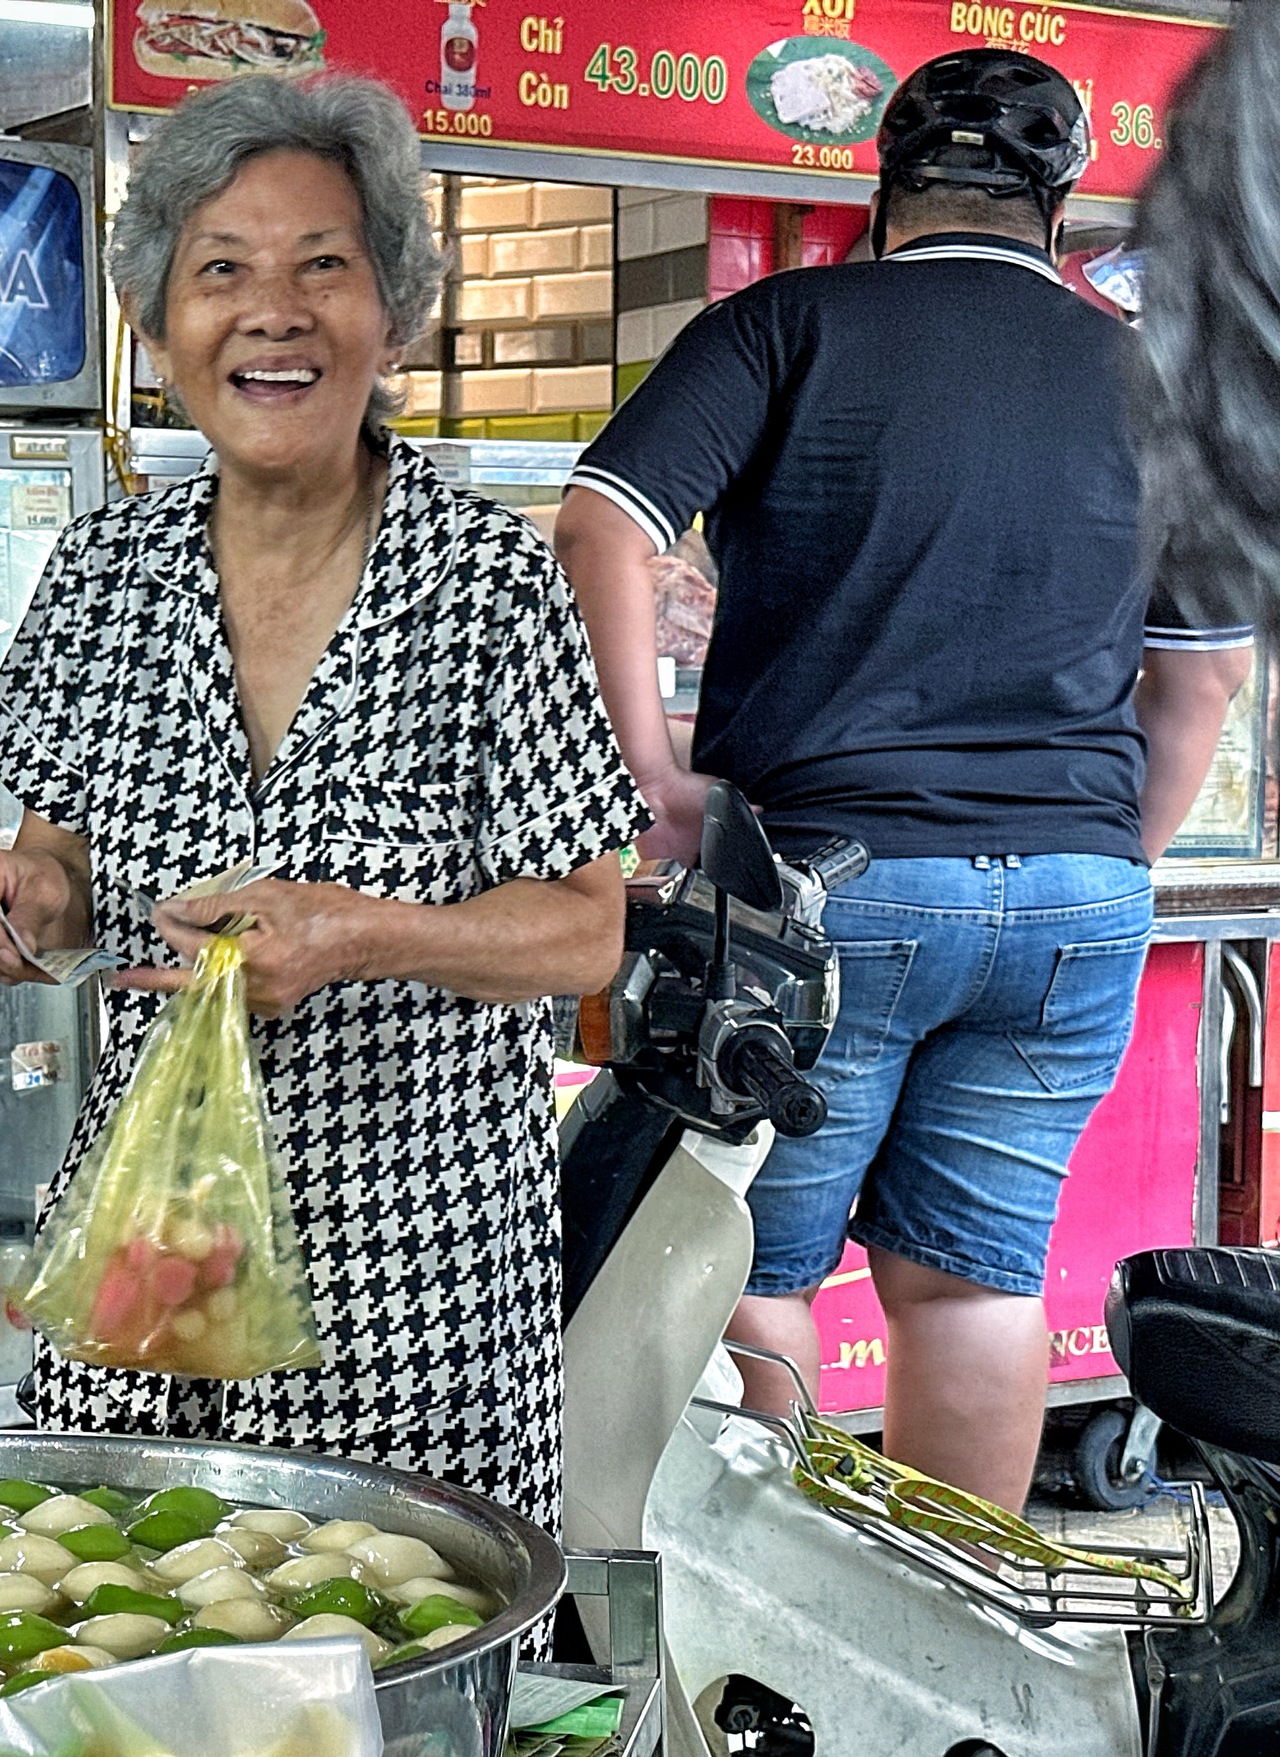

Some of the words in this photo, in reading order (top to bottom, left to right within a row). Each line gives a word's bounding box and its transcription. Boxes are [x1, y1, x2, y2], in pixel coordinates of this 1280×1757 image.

[520, 16, 565, 54] Chỉ
[1020, 6, 1066, 45] CÚC
[519, 70, 569, 109] Còn
[584, 42, 727, 104] 43.000
[423, 108, 493, 137] 15.000
[1110, 101, 1163, 149] 36.
[791, 144, 854, 170] 23.000
